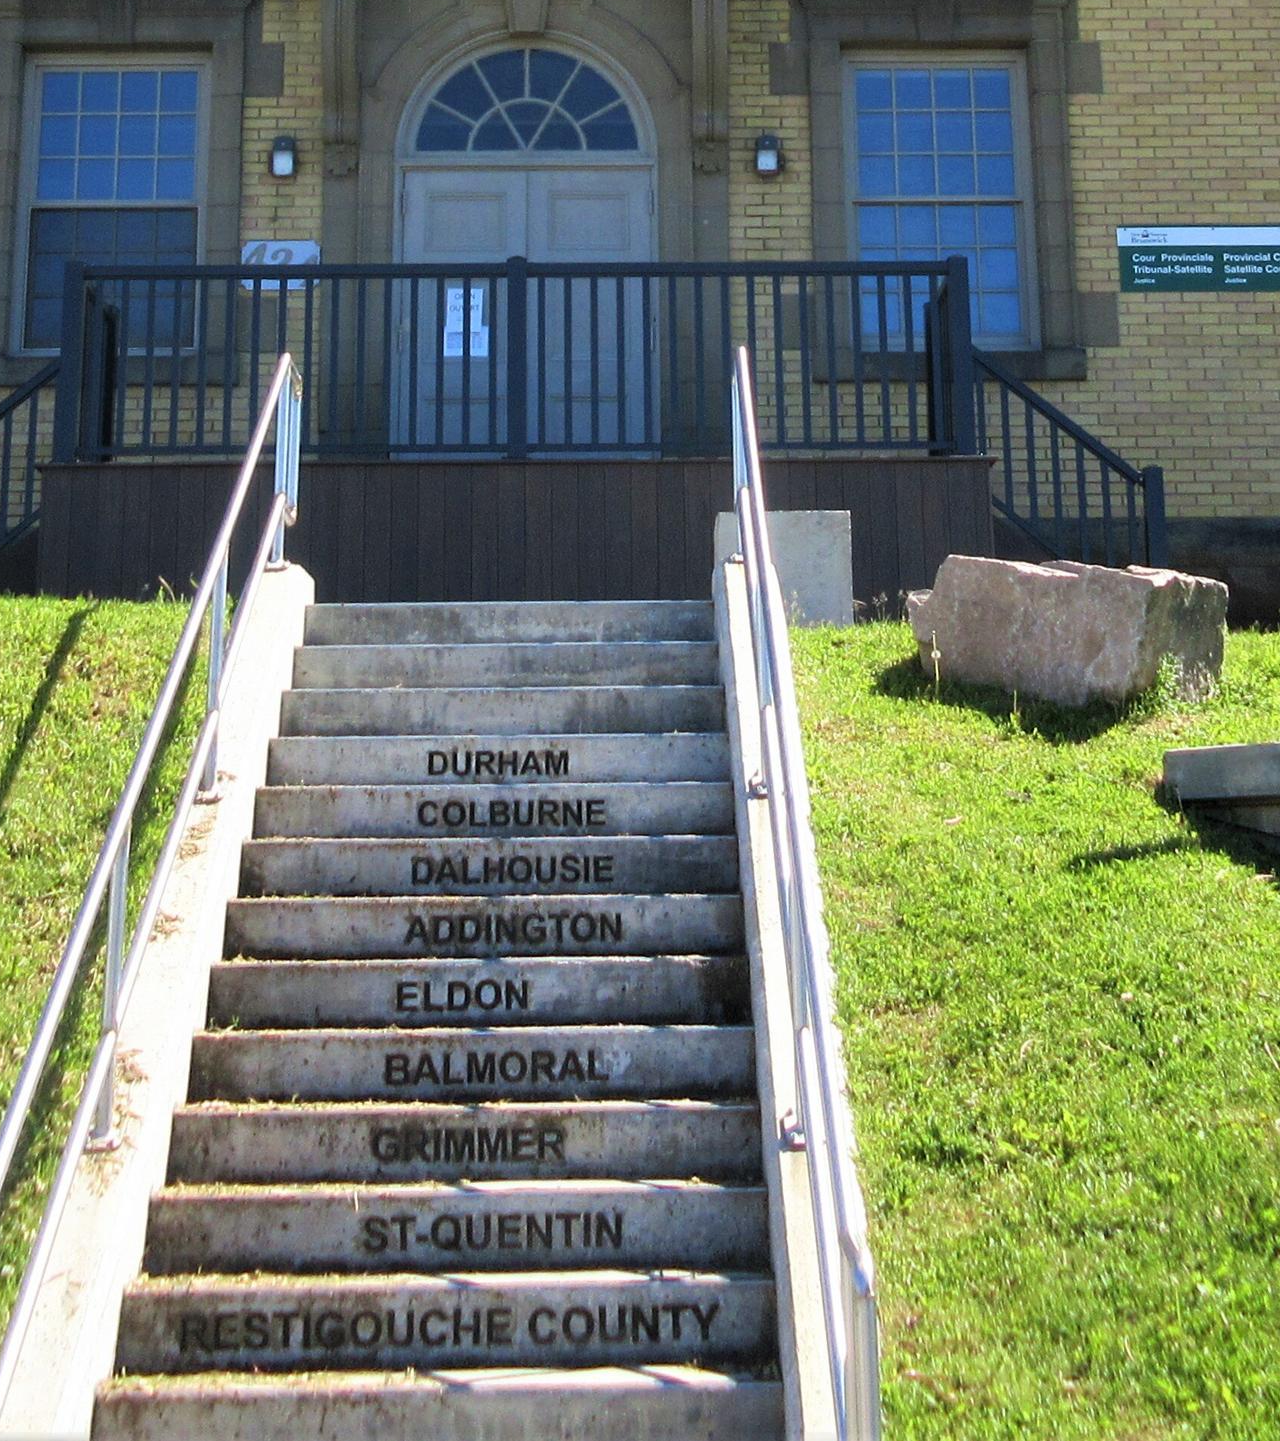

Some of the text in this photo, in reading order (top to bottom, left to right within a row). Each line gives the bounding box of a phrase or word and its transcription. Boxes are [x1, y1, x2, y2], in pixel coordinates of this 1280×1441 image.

[1132, 253, 1214, 262] Cour Provinciale
[1133, 265, 1213, 274] Tribunal-Satellite
[1223, 253, 1271, 262] Provincial
[1224, 264, 1263, 274] Satellite
[426, 749, 571, 777] DURHAM
[416, 799, 607, 829] COLBURNE
[409, 854, 615, 886] DALHOUSIE
[403, 911, 624, 946] ADDINGTON
[394, 978, 531, 1014] ELDON
[382, 1047, 610, 1087] BALMORAL
[370, 1125, 566, 1166] GRIMMER
[362, 1211, 626, 1255] ST-QUENTIN
[179, 1301, 722, 1354] RESTIGOUCHE COUNTY
